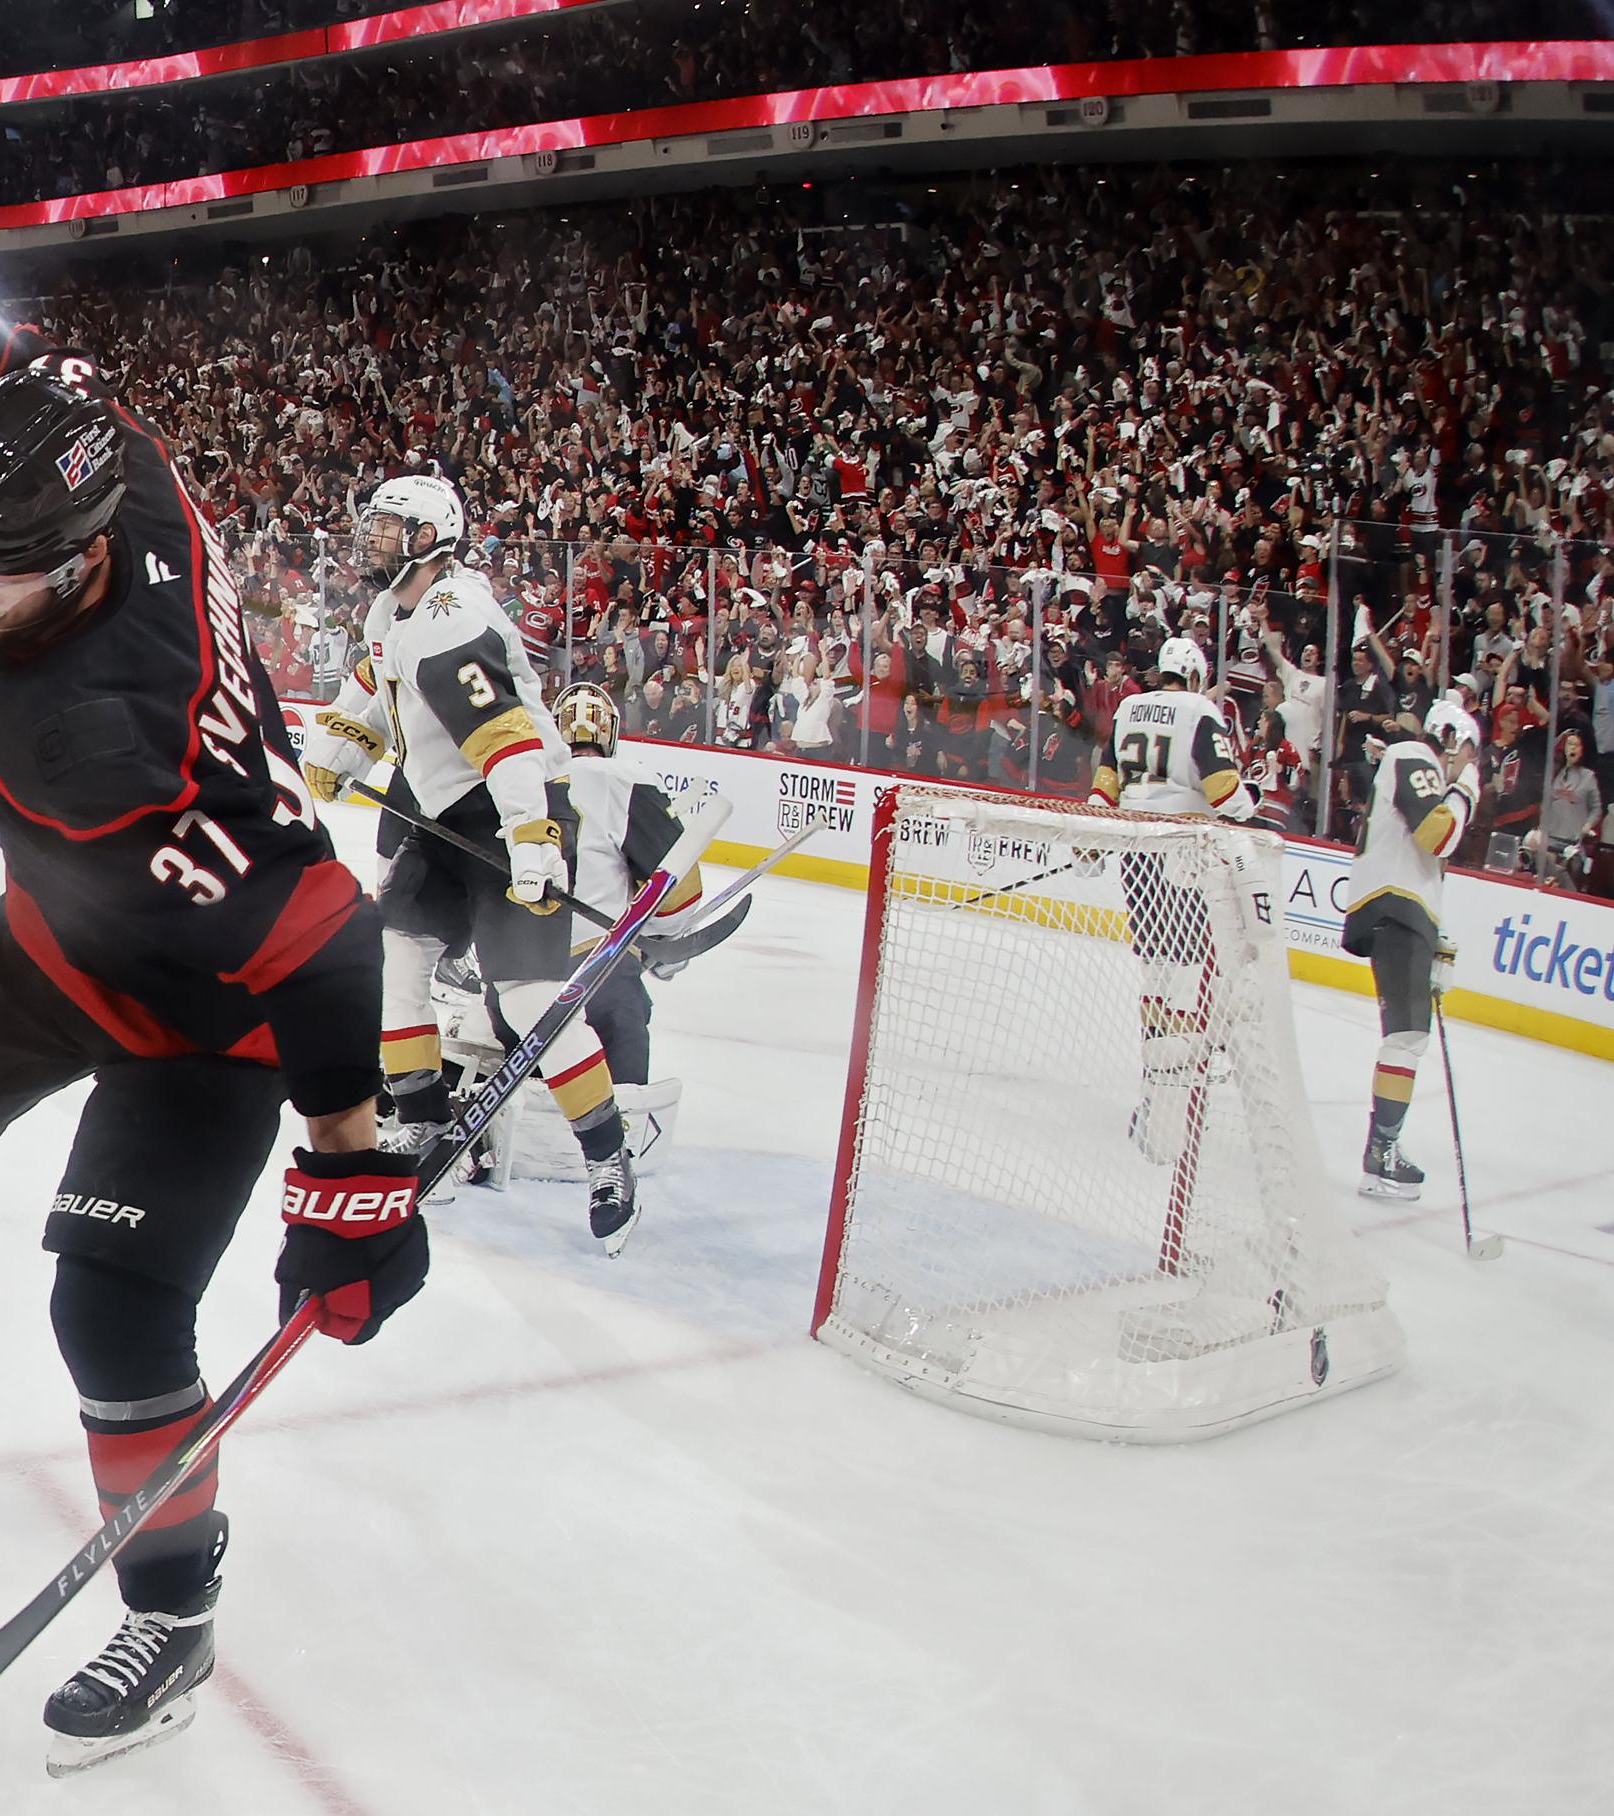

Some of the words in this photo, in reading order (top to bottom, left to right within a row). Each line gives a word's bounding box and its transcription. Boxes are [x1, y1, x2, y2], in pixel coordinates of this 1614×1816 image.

[792, 126, 809, 140] 119
[537, 154, 552, 168] 118
[292, 188, 305, 202] 117
[456, 662, 496, 708] 3
[1129, 704, 1176, 726] HOWDEN
[287, 732, 305, 745] PSI
[330, 721, 378, 751] CCM
[1119, 732, 1171, 786] 21
[779, 772, 834, 803] STORM
[150, 809, 255, 907] 37
[1286, 927, 1341, 950] OMPAN
[463, 1033, 544, 1131] BAUER
[283, 1184, 412, 1222] AUER
[57, 1490, 148, 1597] FLYLITE
[147, 1664, 184, 1709] BAUER
